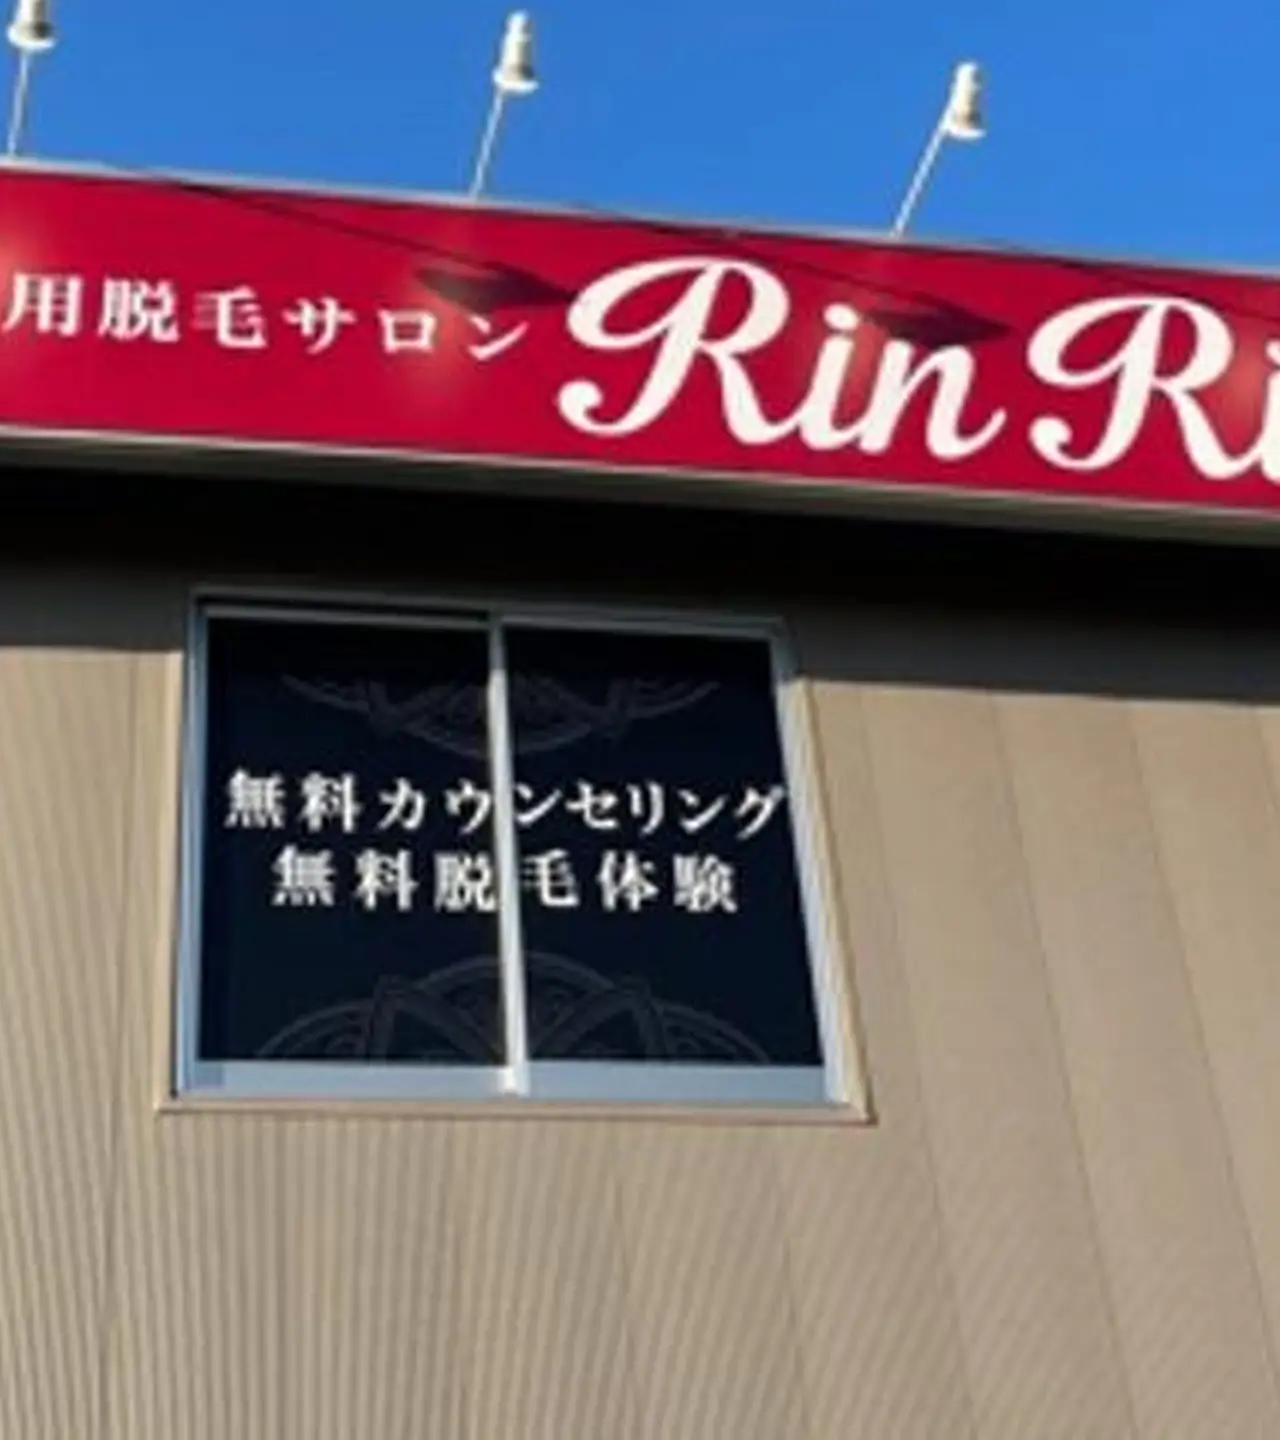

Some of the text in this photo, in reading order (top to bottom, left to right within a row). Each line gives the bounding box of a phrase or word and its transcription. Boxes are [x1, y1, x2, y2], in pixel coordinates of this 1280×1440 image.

[556, 255, 1006, 461] Rin
[225, 768, 786, 839] 無料カウンセリング
[271, 844, 740, 914] 無料脱毛体験
